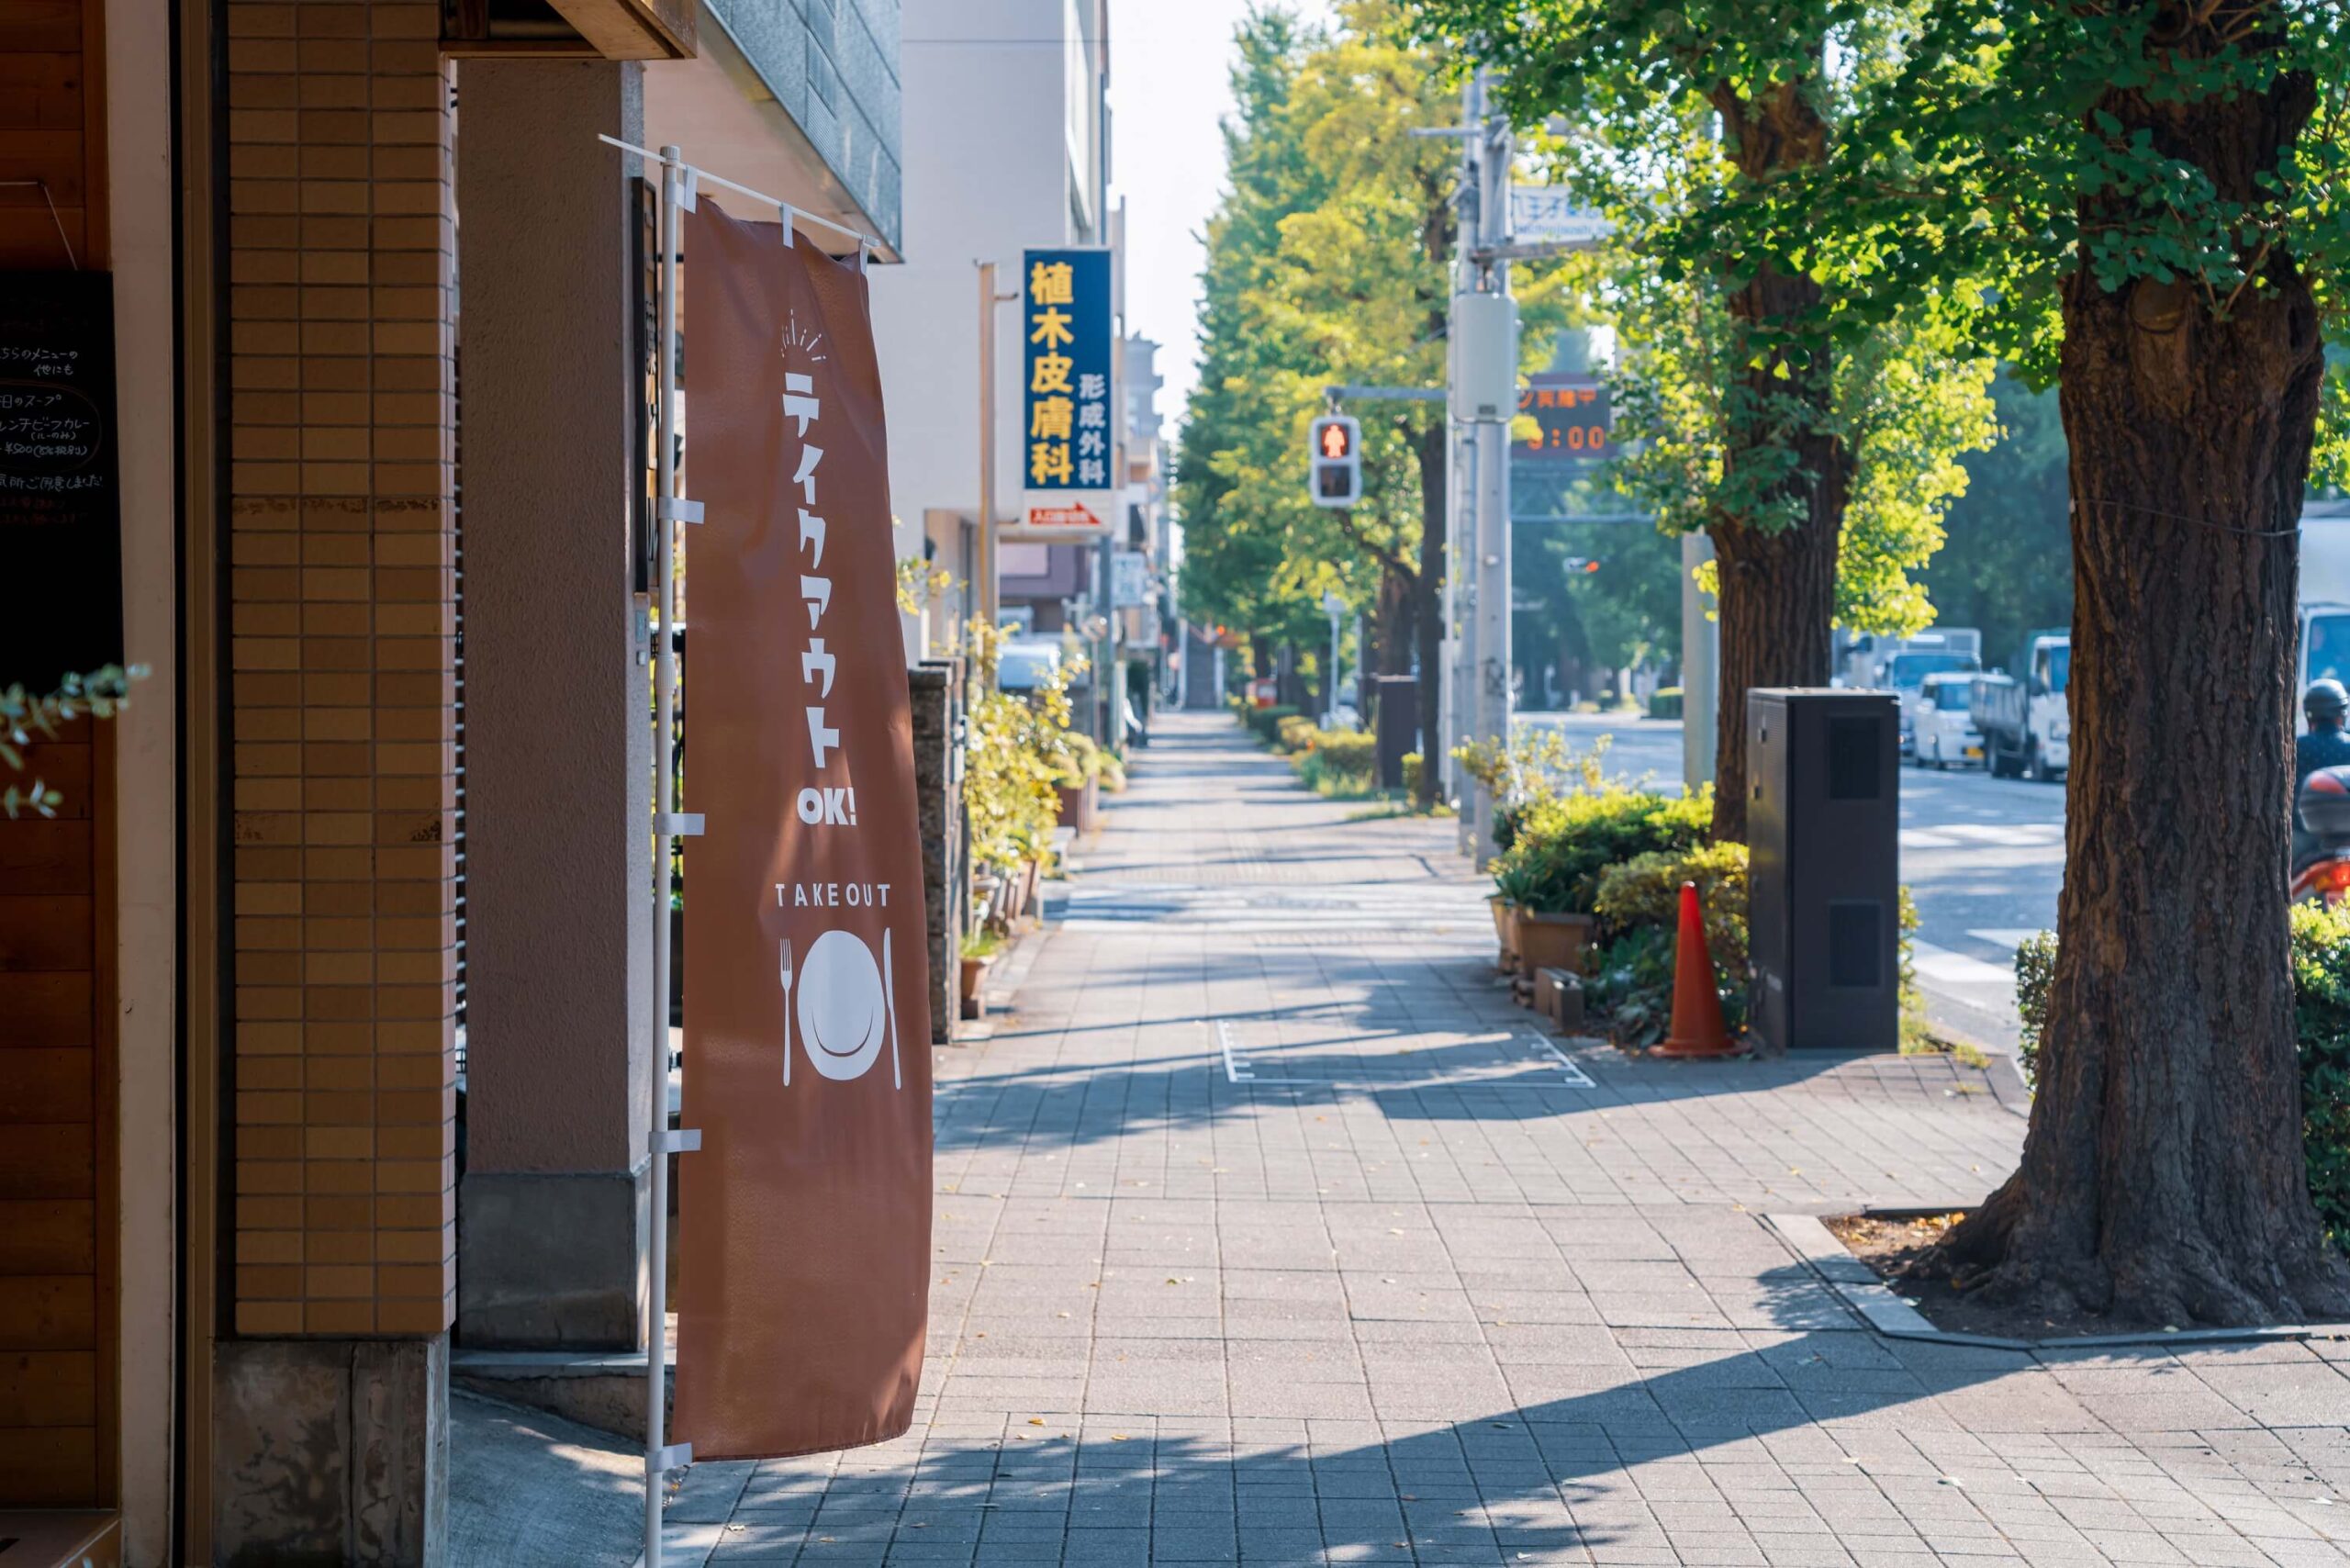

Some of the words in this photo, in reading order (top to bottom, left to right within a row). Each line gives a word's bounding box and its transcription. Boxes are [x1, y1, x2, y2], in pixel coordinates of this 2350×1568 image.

[0, 346, 79, 362] ちらのメニューの
[33, 364, 74, 377] 他にも
[1029, 261, 1075, 486] 植木皮膚科
[0, 393, 62, 409] 日のスープ
[1079, 373, 1106, 485] 形成外科
[782, 372, 840, 769] テイクアウト
[796, 787, 857, 827] OK!
[775, 883, 839, 907] TAKE
[845, 883, 890, 907] OUT
